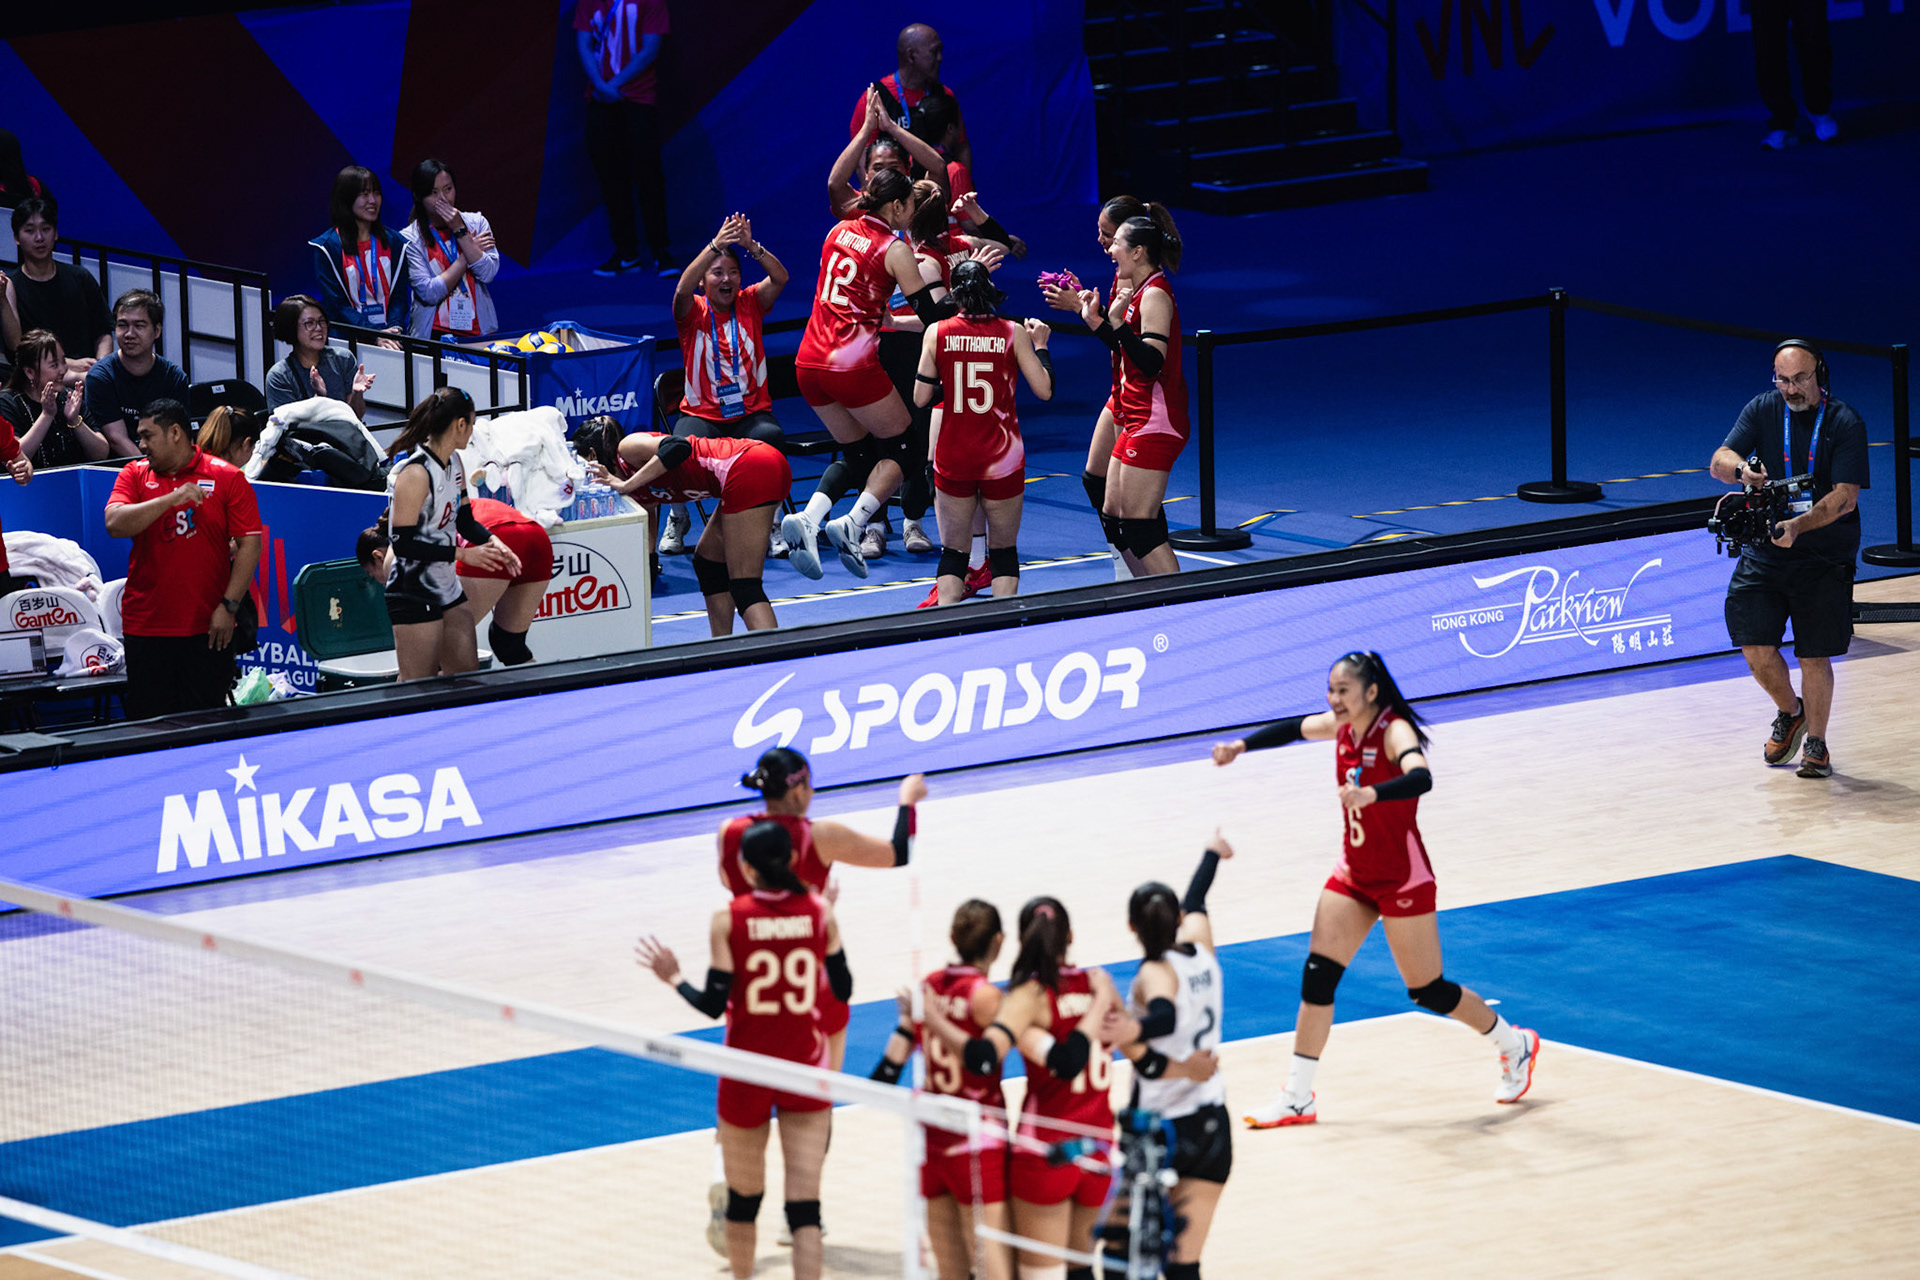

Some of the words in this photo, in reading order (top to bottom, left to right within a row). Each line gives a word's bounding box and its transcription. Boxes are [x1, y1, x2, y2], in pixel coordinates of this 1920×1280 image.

[820, 251, 859, 307] 12
[953, 361, 995, 415] 15
[19, 596, 60, 612] 百岁山
[1431, 616, 1468, 632] HONG
[1469, 610, 1505, 627] KONG
[810, 646, 1147, 755] SPONSOR
[157, 753, 484, 874] MIKASA
[746, 947, 817, 1015] 29
[1193, 1005, 1216, 1051] 2
